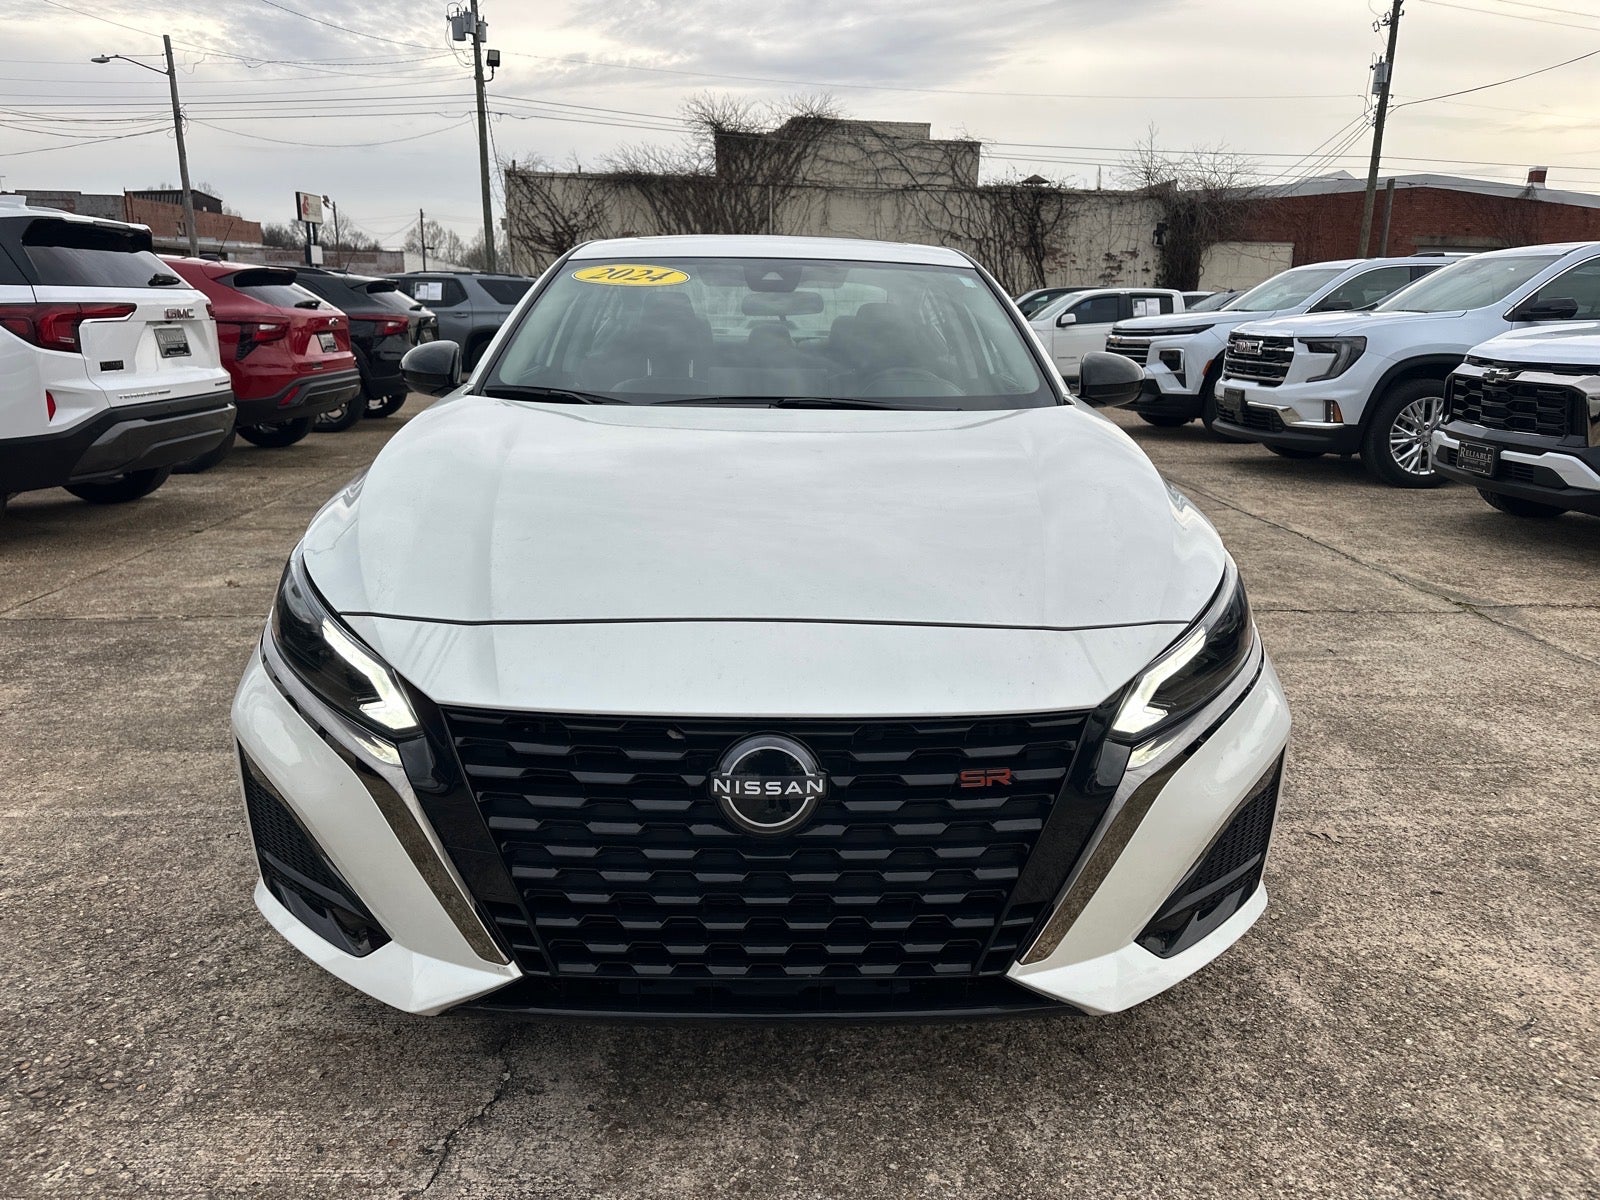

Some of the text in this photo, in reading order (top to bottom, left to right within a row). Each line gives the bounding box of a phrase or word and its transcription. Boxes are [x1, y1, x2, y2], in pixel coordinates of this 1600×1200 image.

[586, 268, 675, 282] 2024
[164, 307, 195, 320] GMC
[960, 768, 1013, 788] SR
[712, 777, 825, 796] NISSAN
